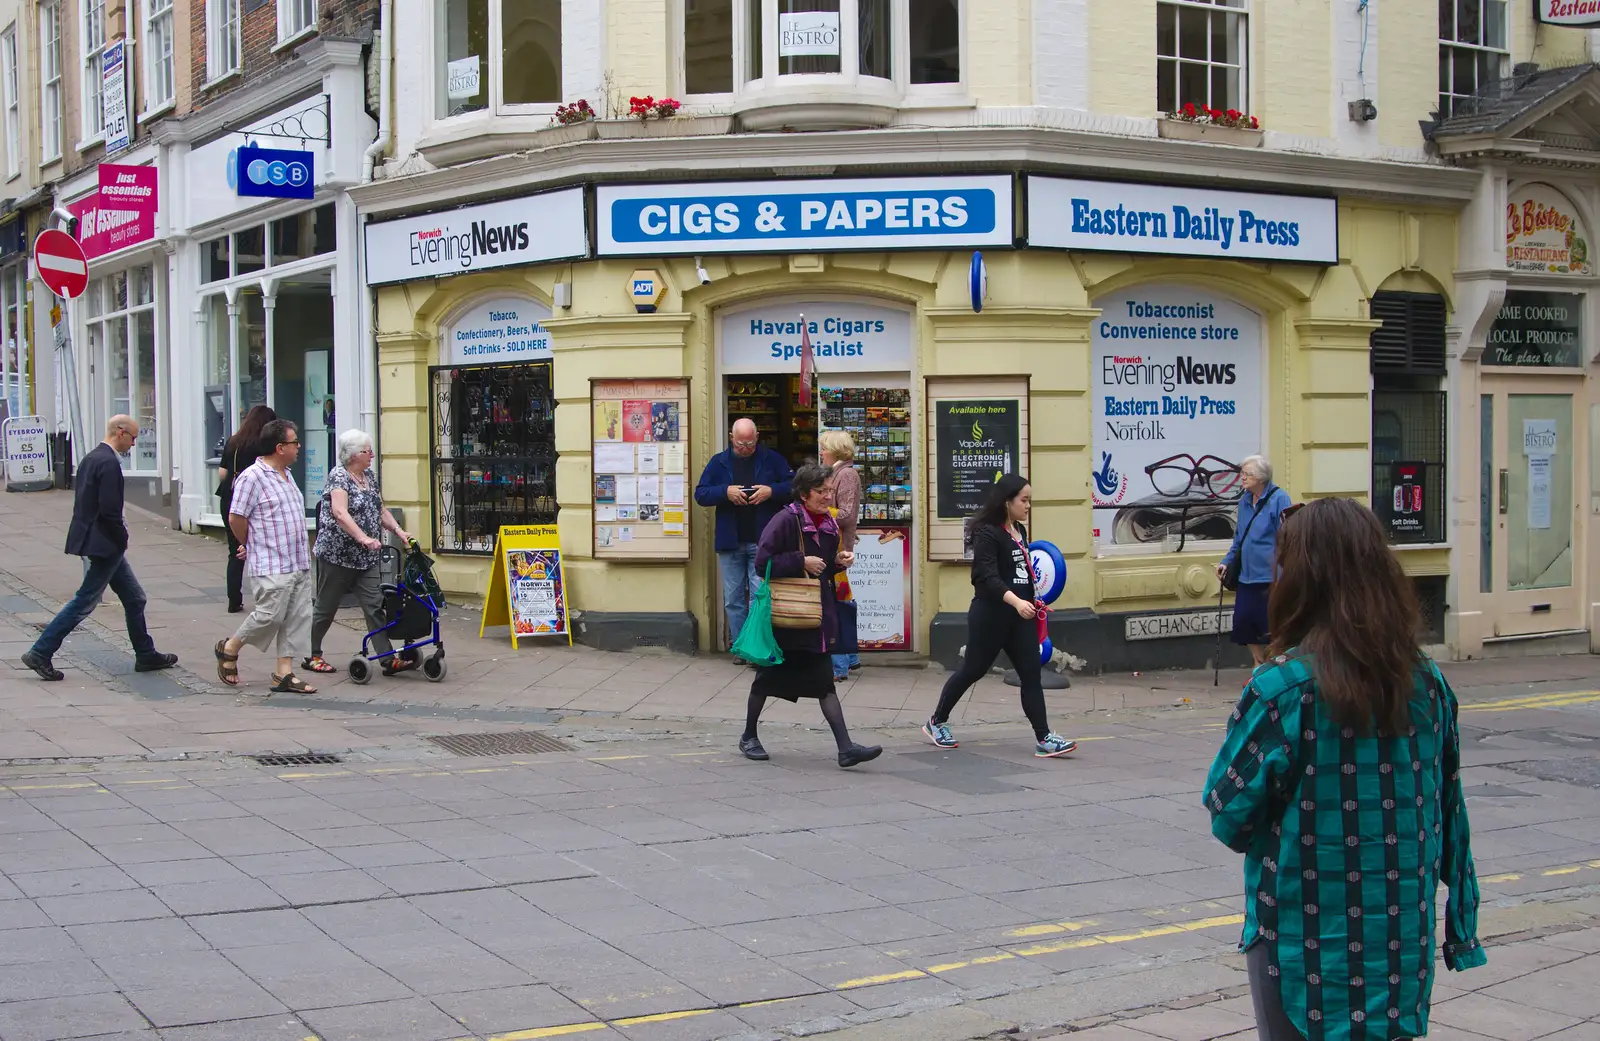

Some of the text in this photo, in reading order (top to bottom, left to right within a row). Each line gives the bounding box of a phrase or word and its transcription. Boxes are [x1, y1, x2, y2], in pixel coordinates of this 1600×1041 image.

[788, 21, 799, 31] LE
[784, 31, 834, 45] BISTRO
[453, 69, 459, 78] LE
[450, 74, 478, 91] BISTRO
[106, 116, 125, 138] TO LET
[116, 172, 136, 184] just
[256, 166, 302, 181] TSB
[102, 186, 152, 197] essentials
[638, 196, 969, 235] CIGS & PAPERS
[1522, 200, 1570, 236] Bistro
[80, 207, 96, 243] just
[1071, 198, 1300, 250] Eastern Daily Press
[110, 224, 140, 243] beauty stores
[418, 228, 442, 240] Norwich
[1514, 247, 1569, 262] RESTAURANT
[634, 283, 653, 292] ADT
[489, 311, 519, 322] Tobacco,
[1126, 301, 1214, 318] Tobacconist
[1525, 306, 1568, 321] COOKED
[457, 329, 505, 340] Confectionery,
[507, 326, 530, 337] Beers,
[824, 318, 885, 336] Cigars
[1100, 322, 1239, 340] Convenience store
[1488, 330, 1574, 345] LOCAL PRODUCE
[464, 346, 477, 355] Soft
[479, 344, 500, 354] Drinks
[507, 341, 525, 352] SOLD
[528, 339, 547, 350] HERE
[771, 341, 863, 360] Speialist
[1114, 356, 1142, 364] Norwich
[1496, 348, 1513, 362] The
[1516, 349, 1540, 366] place
[1544, 349, 1552, 362] to
[949, 406, 1006, 414] Available here
[1105, 396, 1236, 419] Eastern Daily Press
[9, 428, 44, 436] EYEBROW
[1106, 420, 1166, 441] Norfolk
[1525, 434, 1554, 446] BISTRO
[21, 444, 33, 452] £5
[22, 465, 35, 474] £5
[1114, 476, 1128, 504] Lottery
[504, 528, 526, 536] Eastern
[527, 528, 541, 536] Daily
[856, 553, 868, 561] Try
[851, 579, 865, 587] only
[1129, 616, 1208, 636] EXCHANGE
